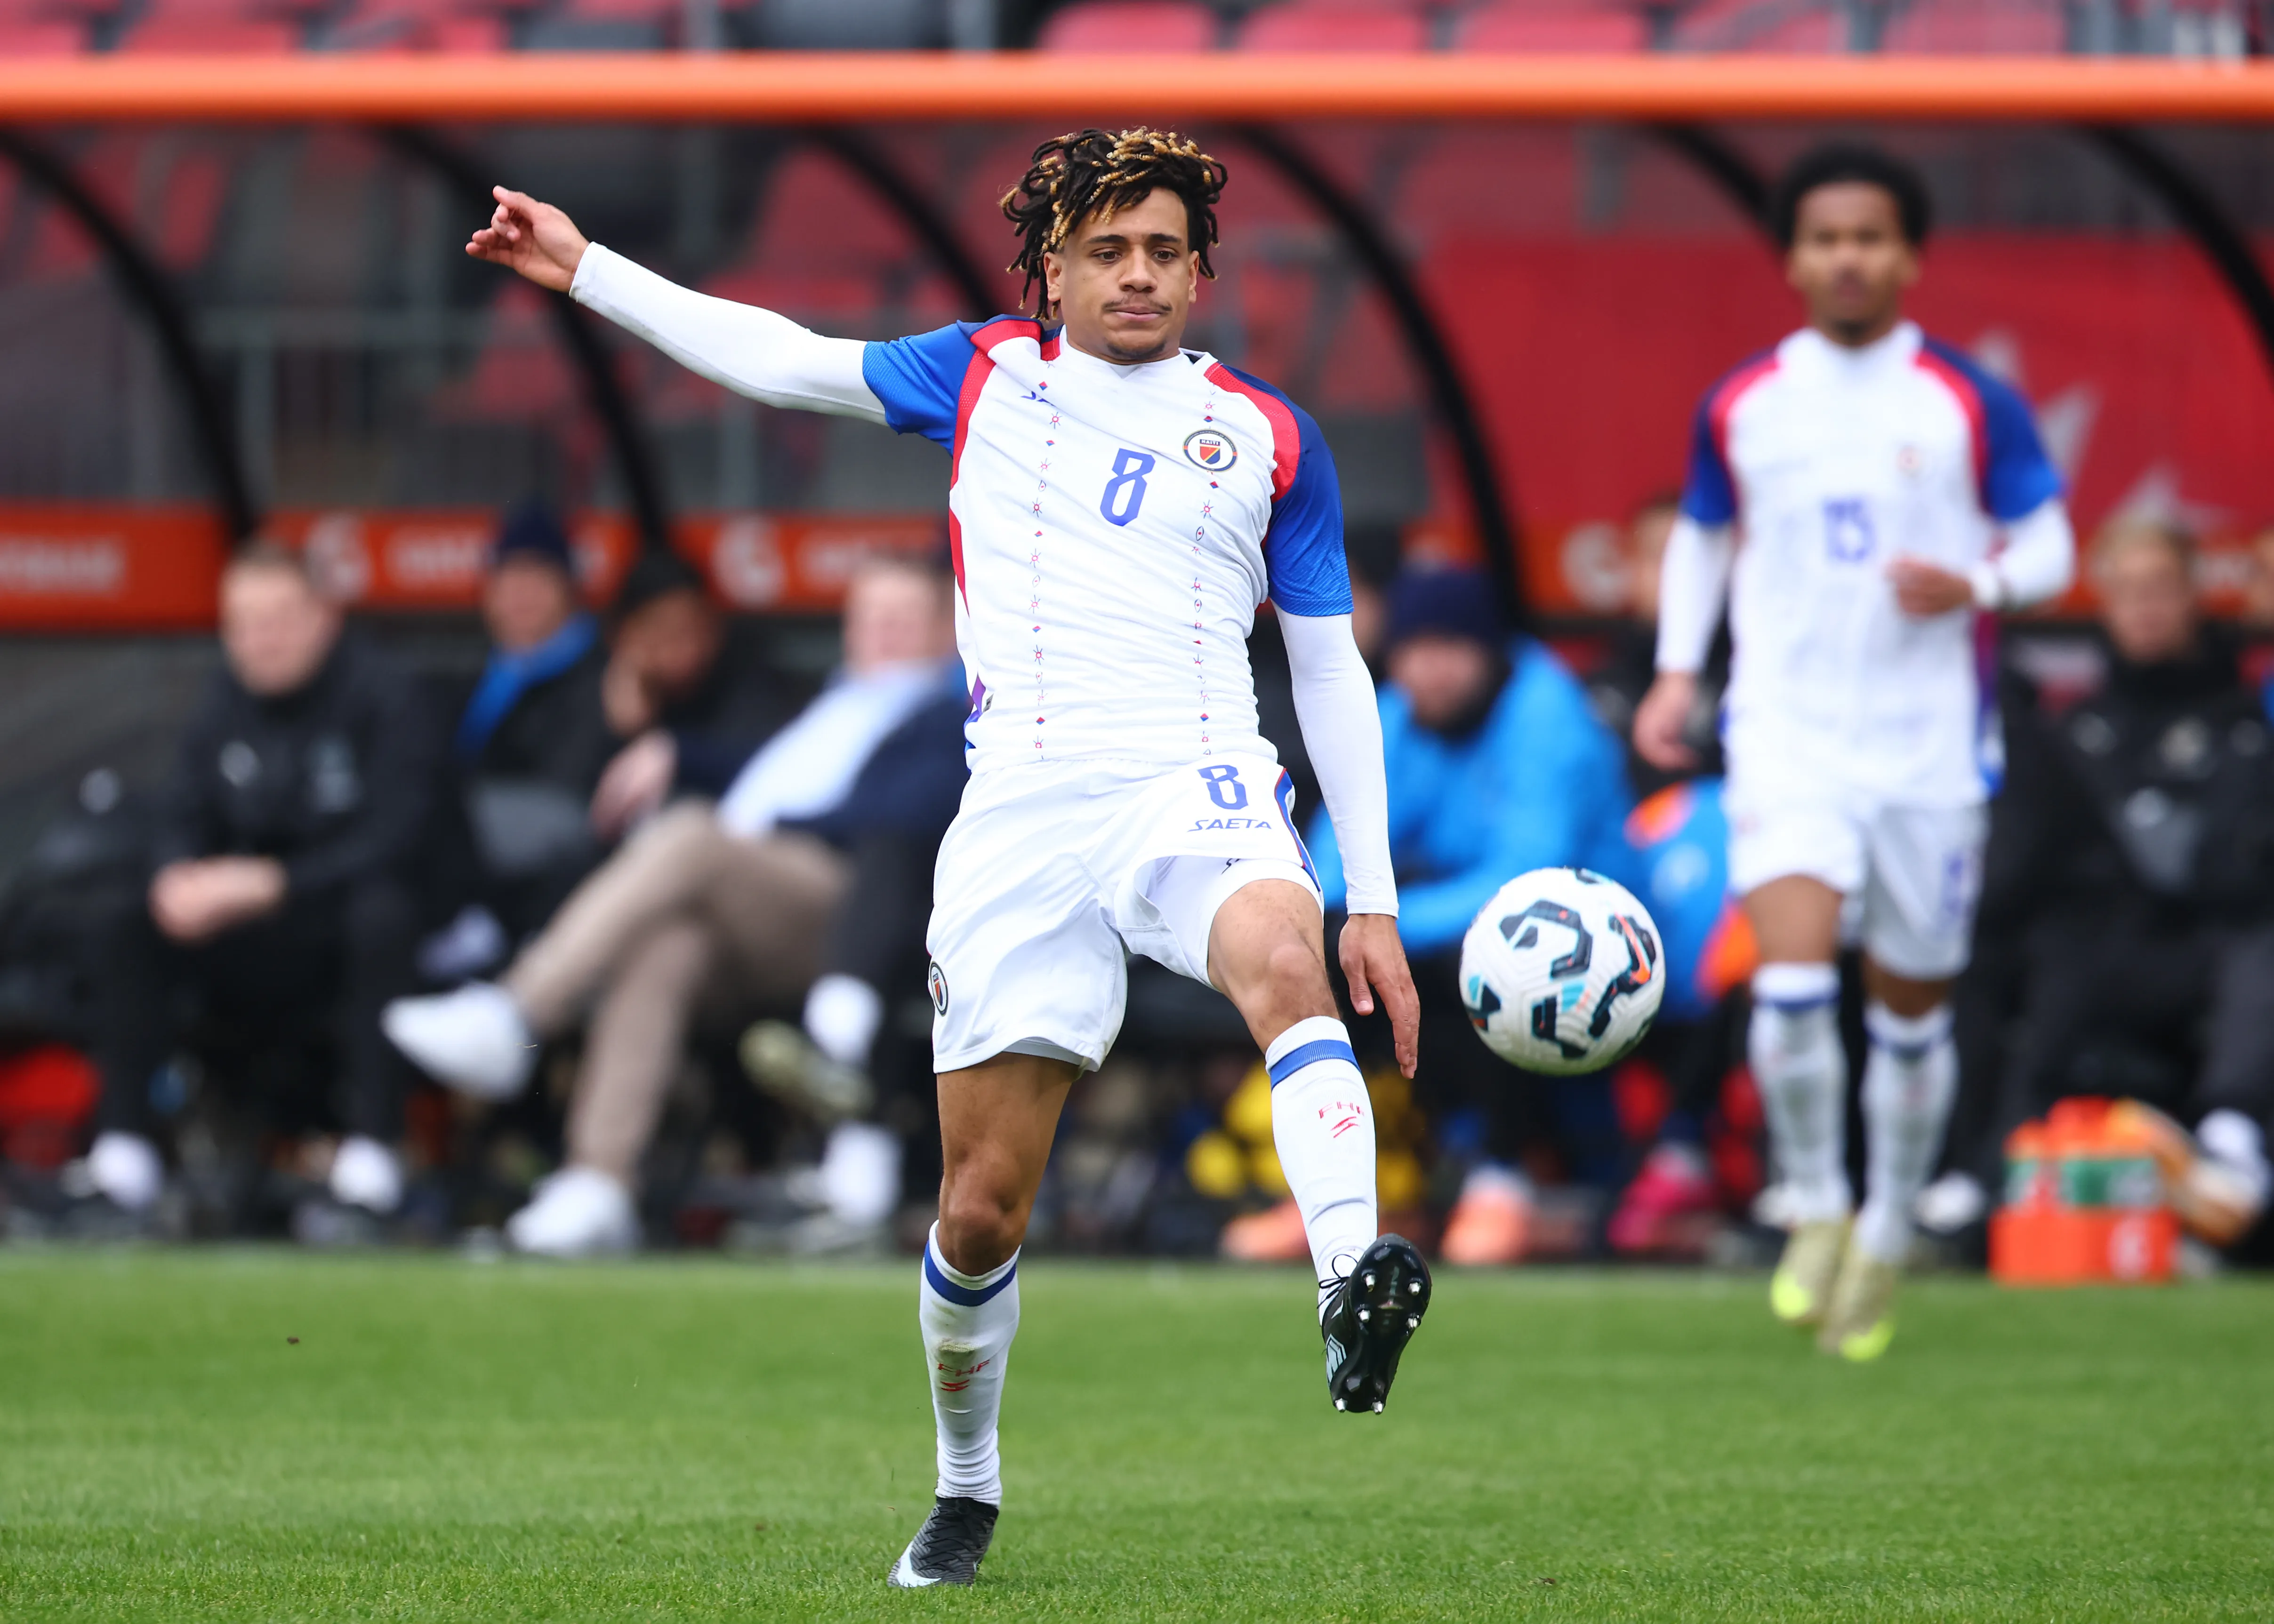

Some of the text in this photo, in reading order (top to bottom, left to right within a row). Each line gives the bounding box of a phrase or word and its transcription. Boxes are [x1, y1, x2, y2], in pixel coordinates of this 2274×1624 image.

[1100, 448, 1157, 527] 8
[1197, 764, 1249, 810] 8
[1187, 818, 1272, 832] SAETA
[937, 1359, 990, 1377] FHF
